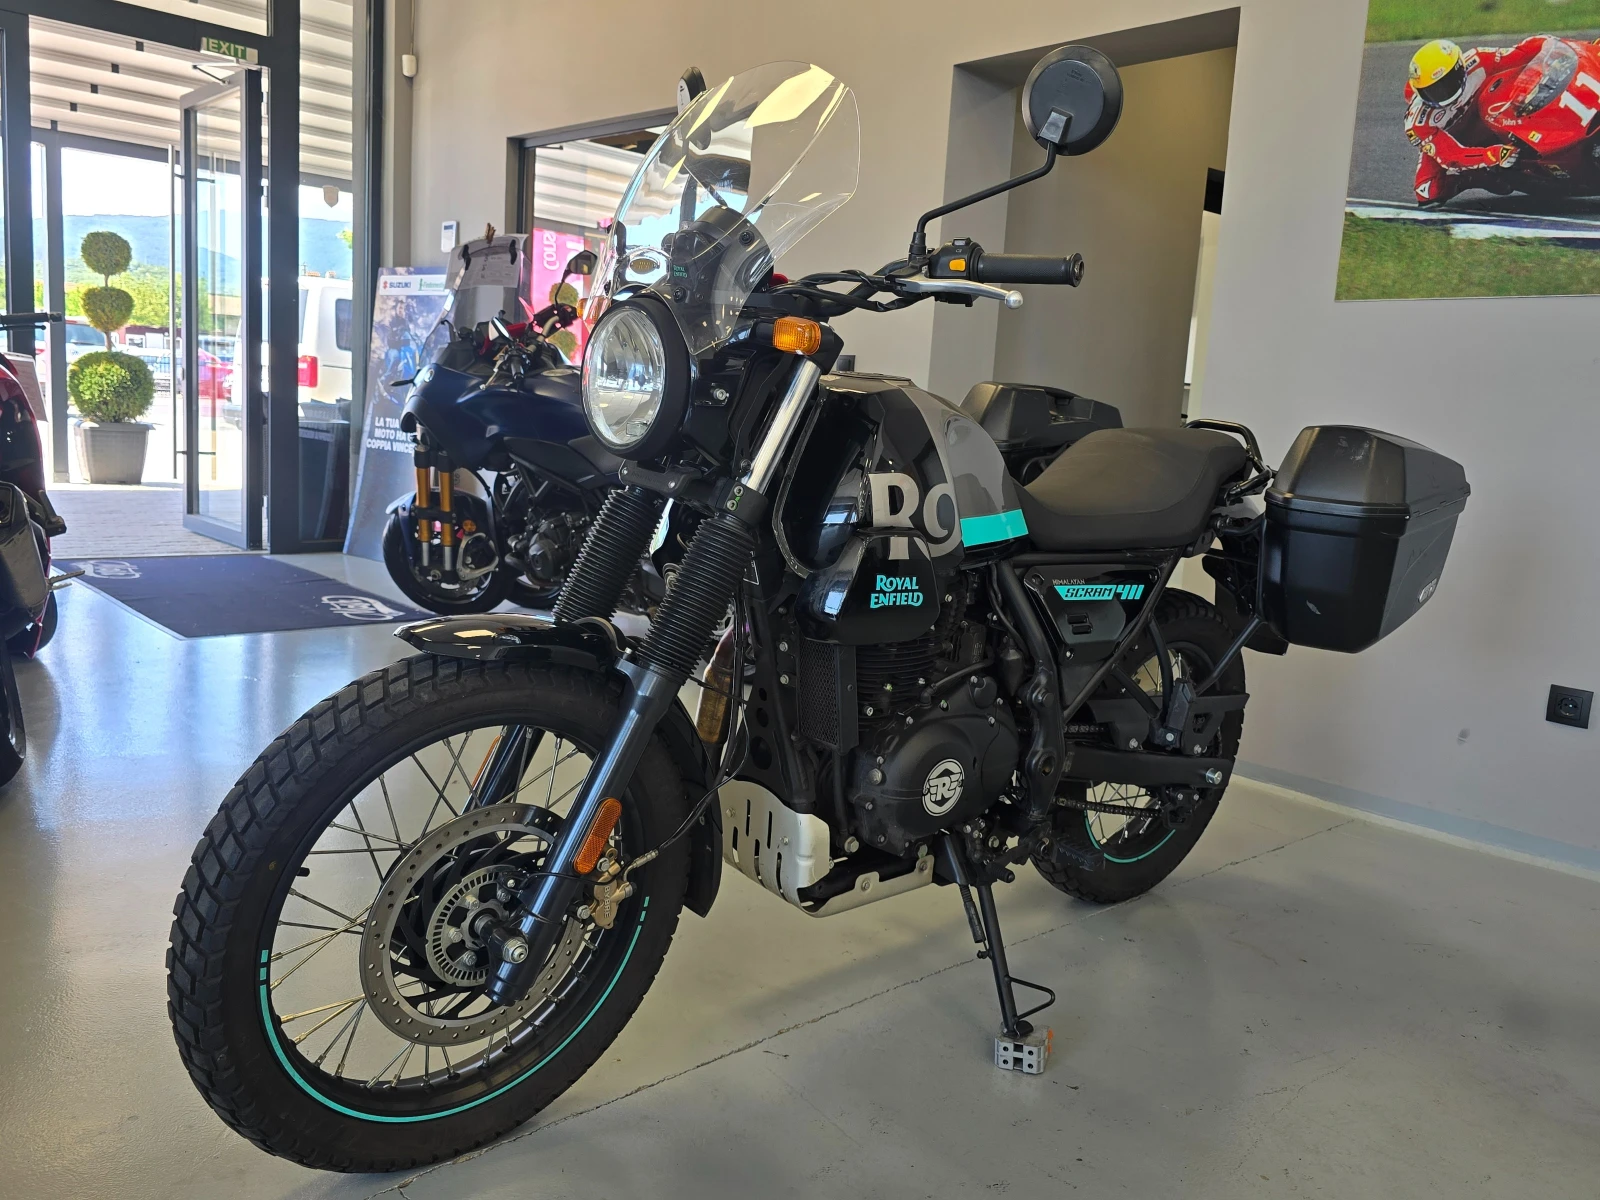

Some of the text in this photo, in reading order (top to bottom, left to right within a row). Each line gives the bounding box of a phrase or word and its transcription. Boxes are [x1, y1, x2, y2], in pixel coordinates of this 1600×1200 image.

[208, 38, 245, 58] EXIT
[375, 416, 400, 429] LA TUA
[374, 427, 396, 440] MOTO
[366, 438, 415, 454] COPPIA VINCE
[876, 574, 919, 592] ROYAL
[870, 592, 924, 609] ENFIELD
[1064, 587, 1113, 598] SCRAM
[603, 885, 611, 918] BYBRE
